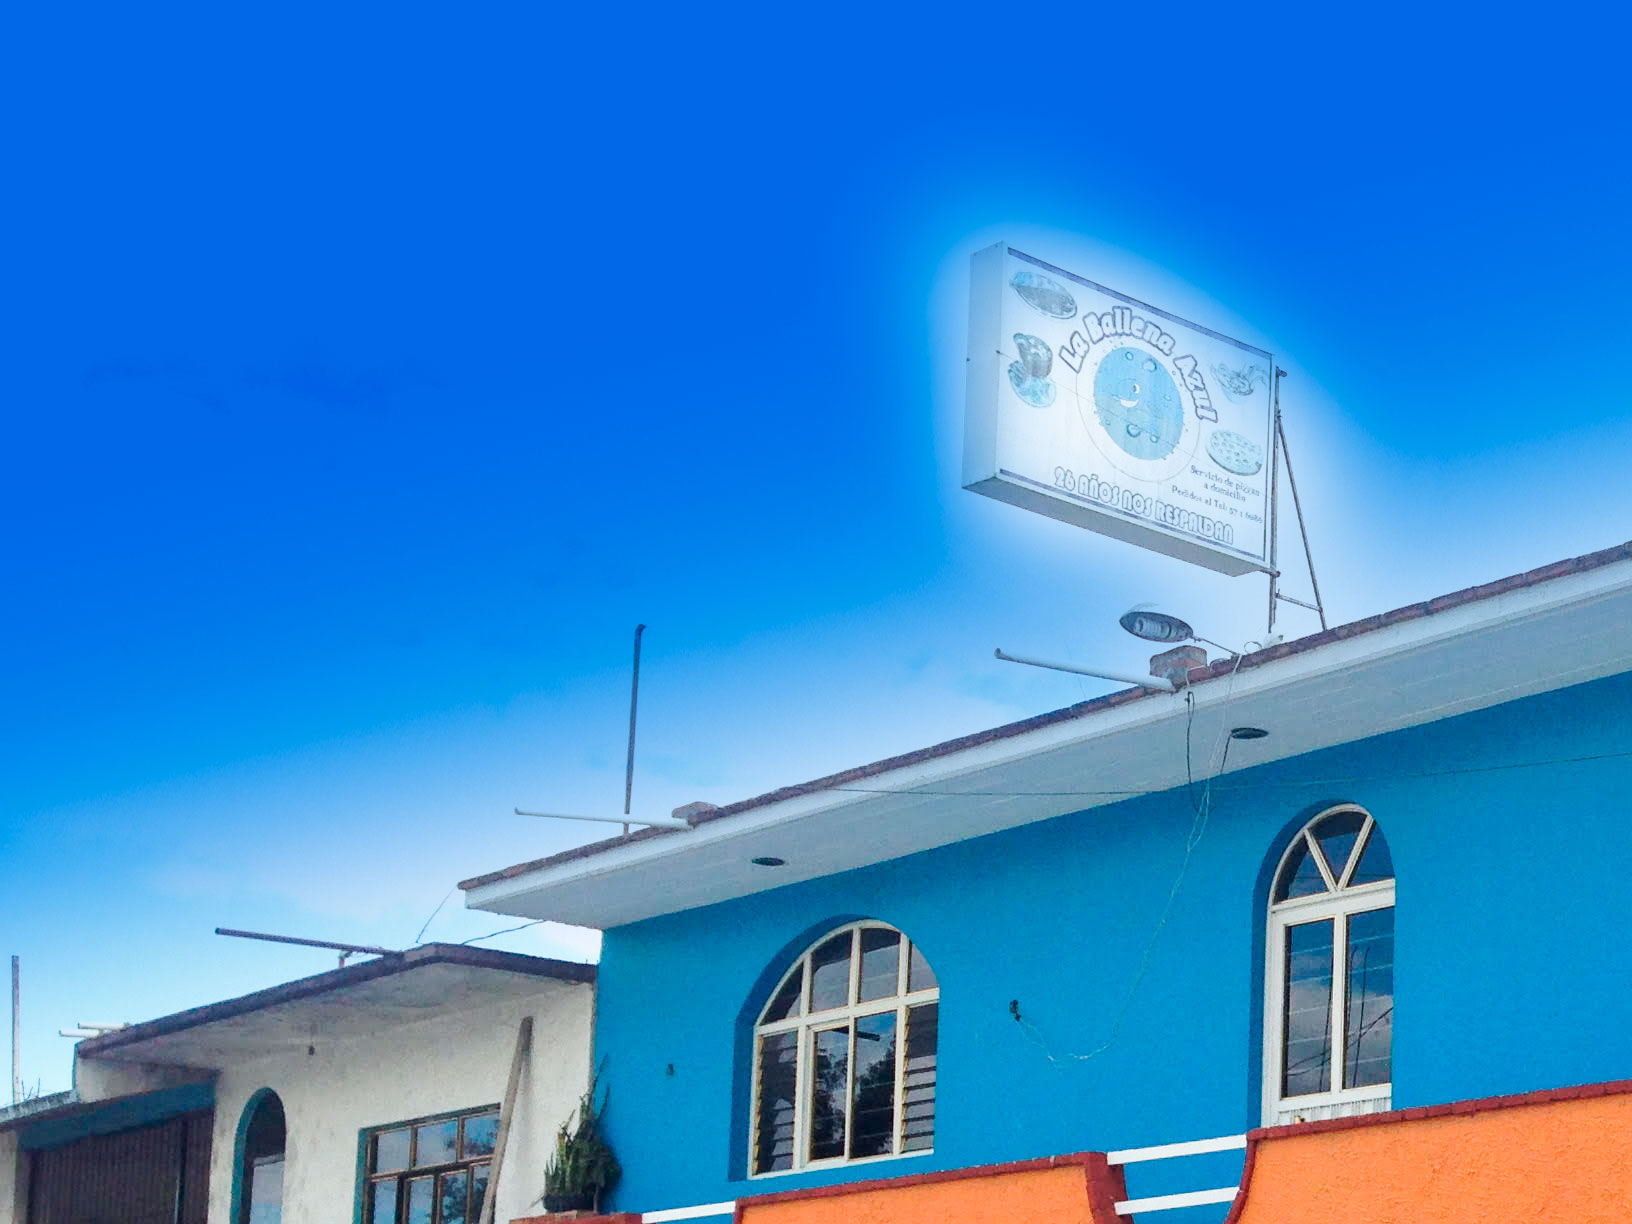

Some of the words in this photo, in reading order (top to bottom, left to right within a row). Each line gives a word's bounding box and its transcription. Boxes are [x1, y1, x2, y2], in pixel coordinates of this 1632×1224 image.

[1058, 330, 1090, 374] La
[1082, 306, 1176, 357] Ballena
[1054, 466, 1076, 492] 26
[1077, 473, 1120, 506] AÑOS
[1121, 489, 1153, 517] NOS
[1154, 500, 1234, 546] RESPALDAN
